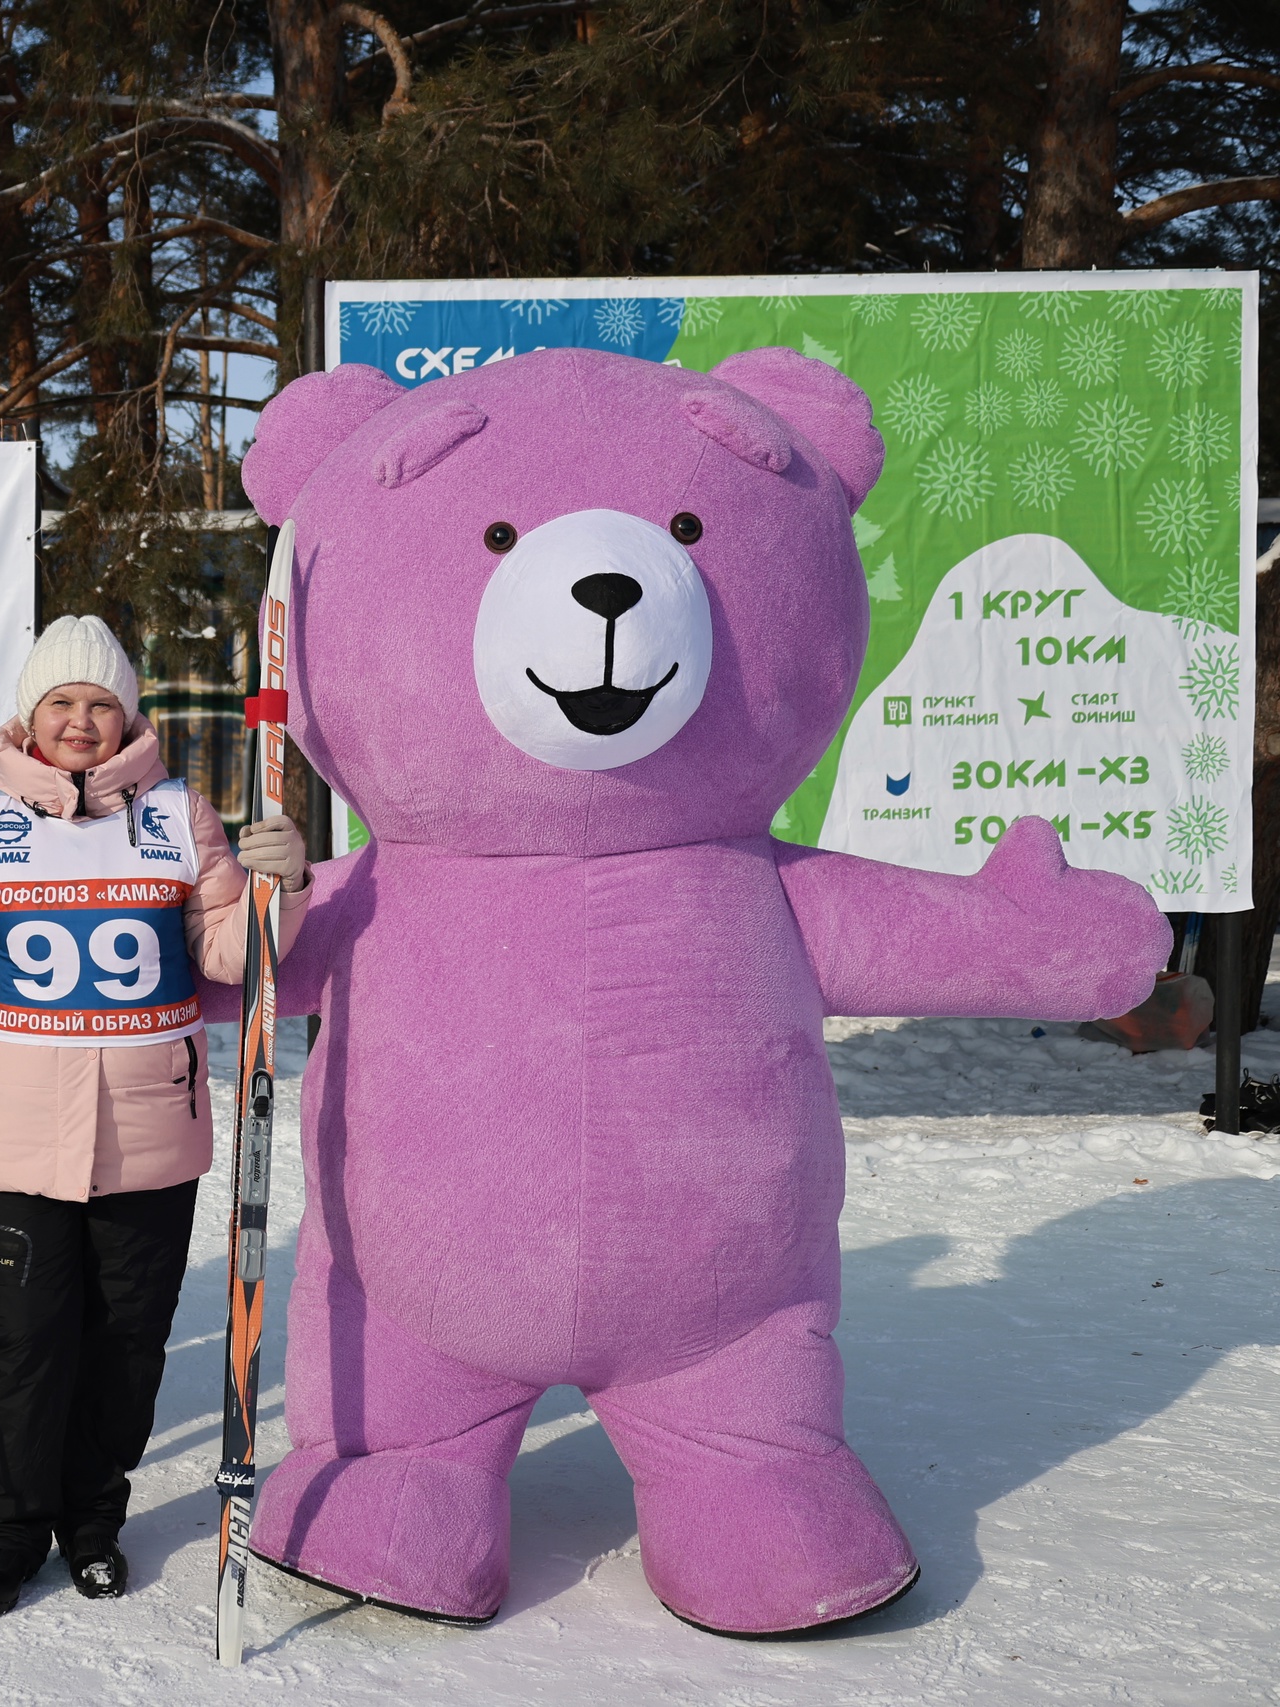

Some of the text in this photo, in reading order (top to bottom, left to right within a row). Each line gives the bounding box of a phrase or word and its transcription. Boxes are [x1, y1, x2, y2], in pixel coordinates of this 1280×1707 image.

[395, 346, 546, 379] СХЕ
[948, 588, 1087, 620] 1 КРУГ
[1014, 634, 1127, 666] 10КМ
[922, 695, 977, 709] ПУНКТ
[1071, 692, 1119, 706] СТАРТ
[922, 713, 999, 727] ПИТАНИЯ
[1071, 709, 1135, 724] ФИНИШ
[952, 758, 1067, 790] 30КМ
[862, 806, 932, 821] ТРАНЗИТ
[140, 849, 182, 863] KAMAZ
[6, 918, 162, 1001] 99
[91, 1012, 152, 1031] ОБРАЗ
[156, 1003, 198, 1028] ЖИЗНИ!
[262, 978, 276, 1037] ACTIVE
[227, 1496, 251, 1571] ACTI
[236, 1567, 246, 1608] CLASSIC
